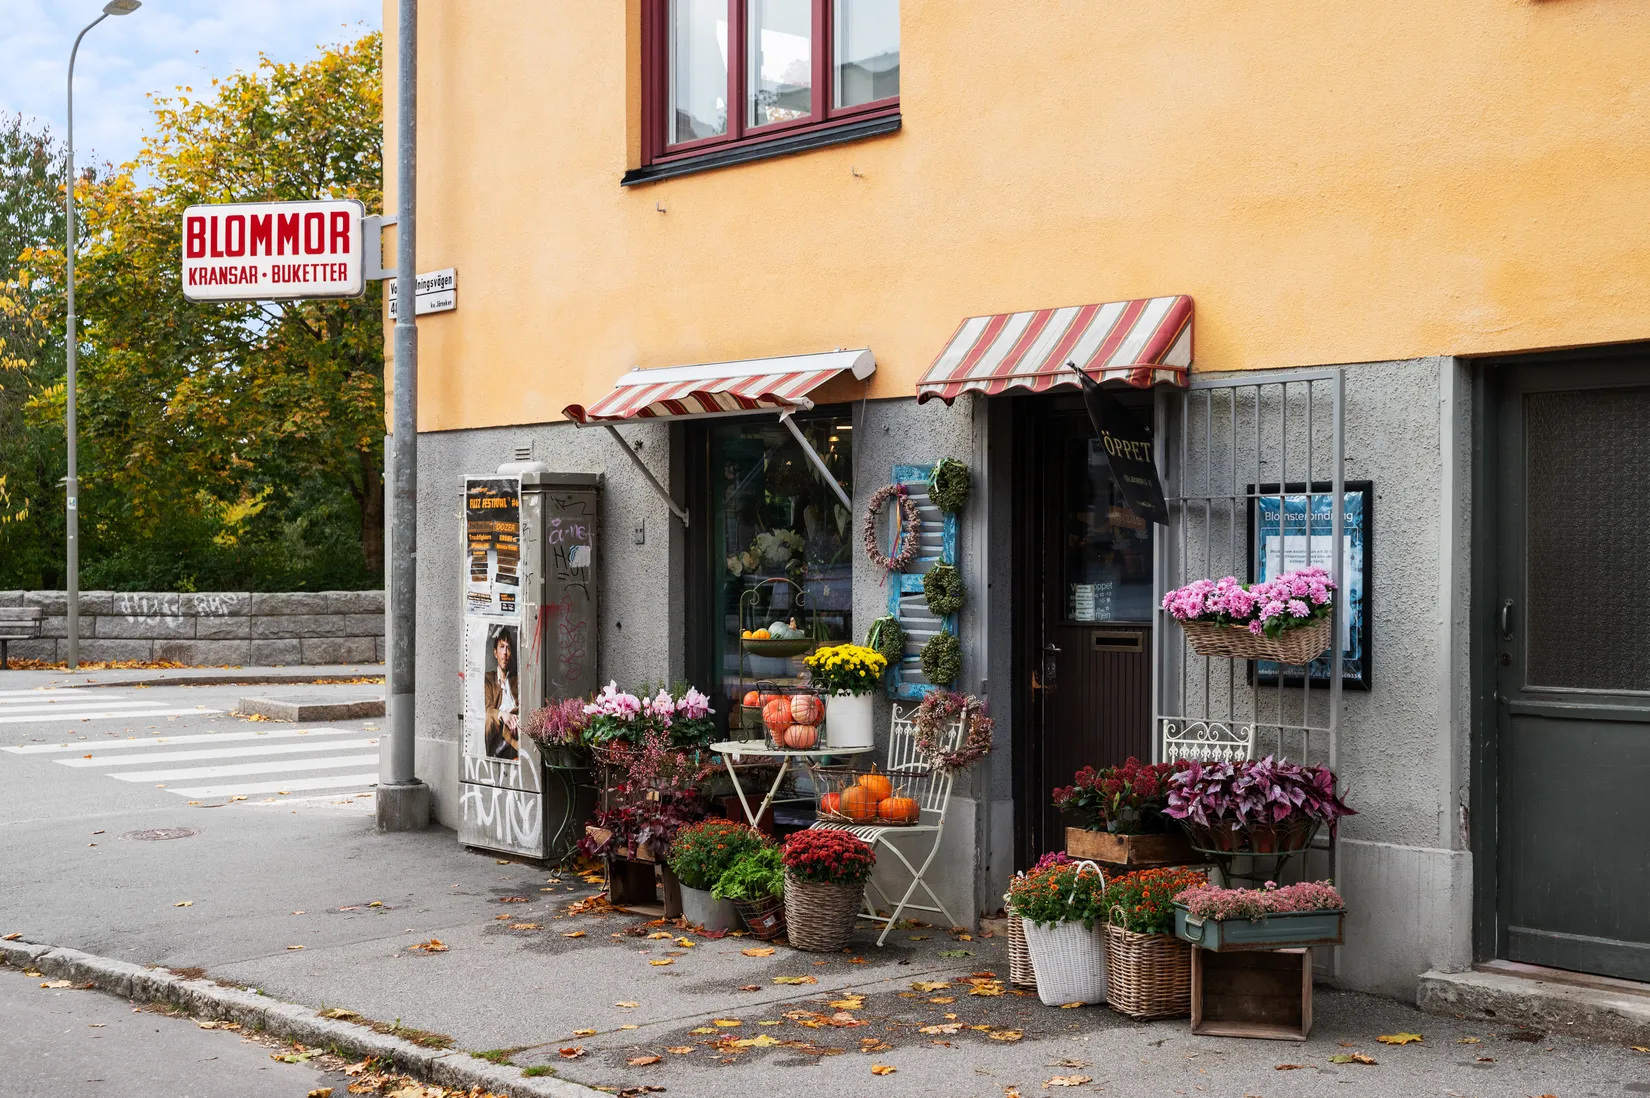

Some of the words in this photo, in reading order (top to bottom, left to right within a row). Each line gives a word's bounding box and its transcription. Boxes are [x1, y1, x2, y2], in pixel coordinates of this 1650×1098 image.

[186, 211, 350, 259] BLOMMOR
[188, 265, 258, 286] KRANSAR
[271, 262, 348, 284] BUKETTER
[1101, 430, 1152, 463] ÖPPET
[469, 498, 481, 509] FUZZ
[482, 497, 507, 509] FESTIVAL
[495, 523, 516, 532] DOZER
